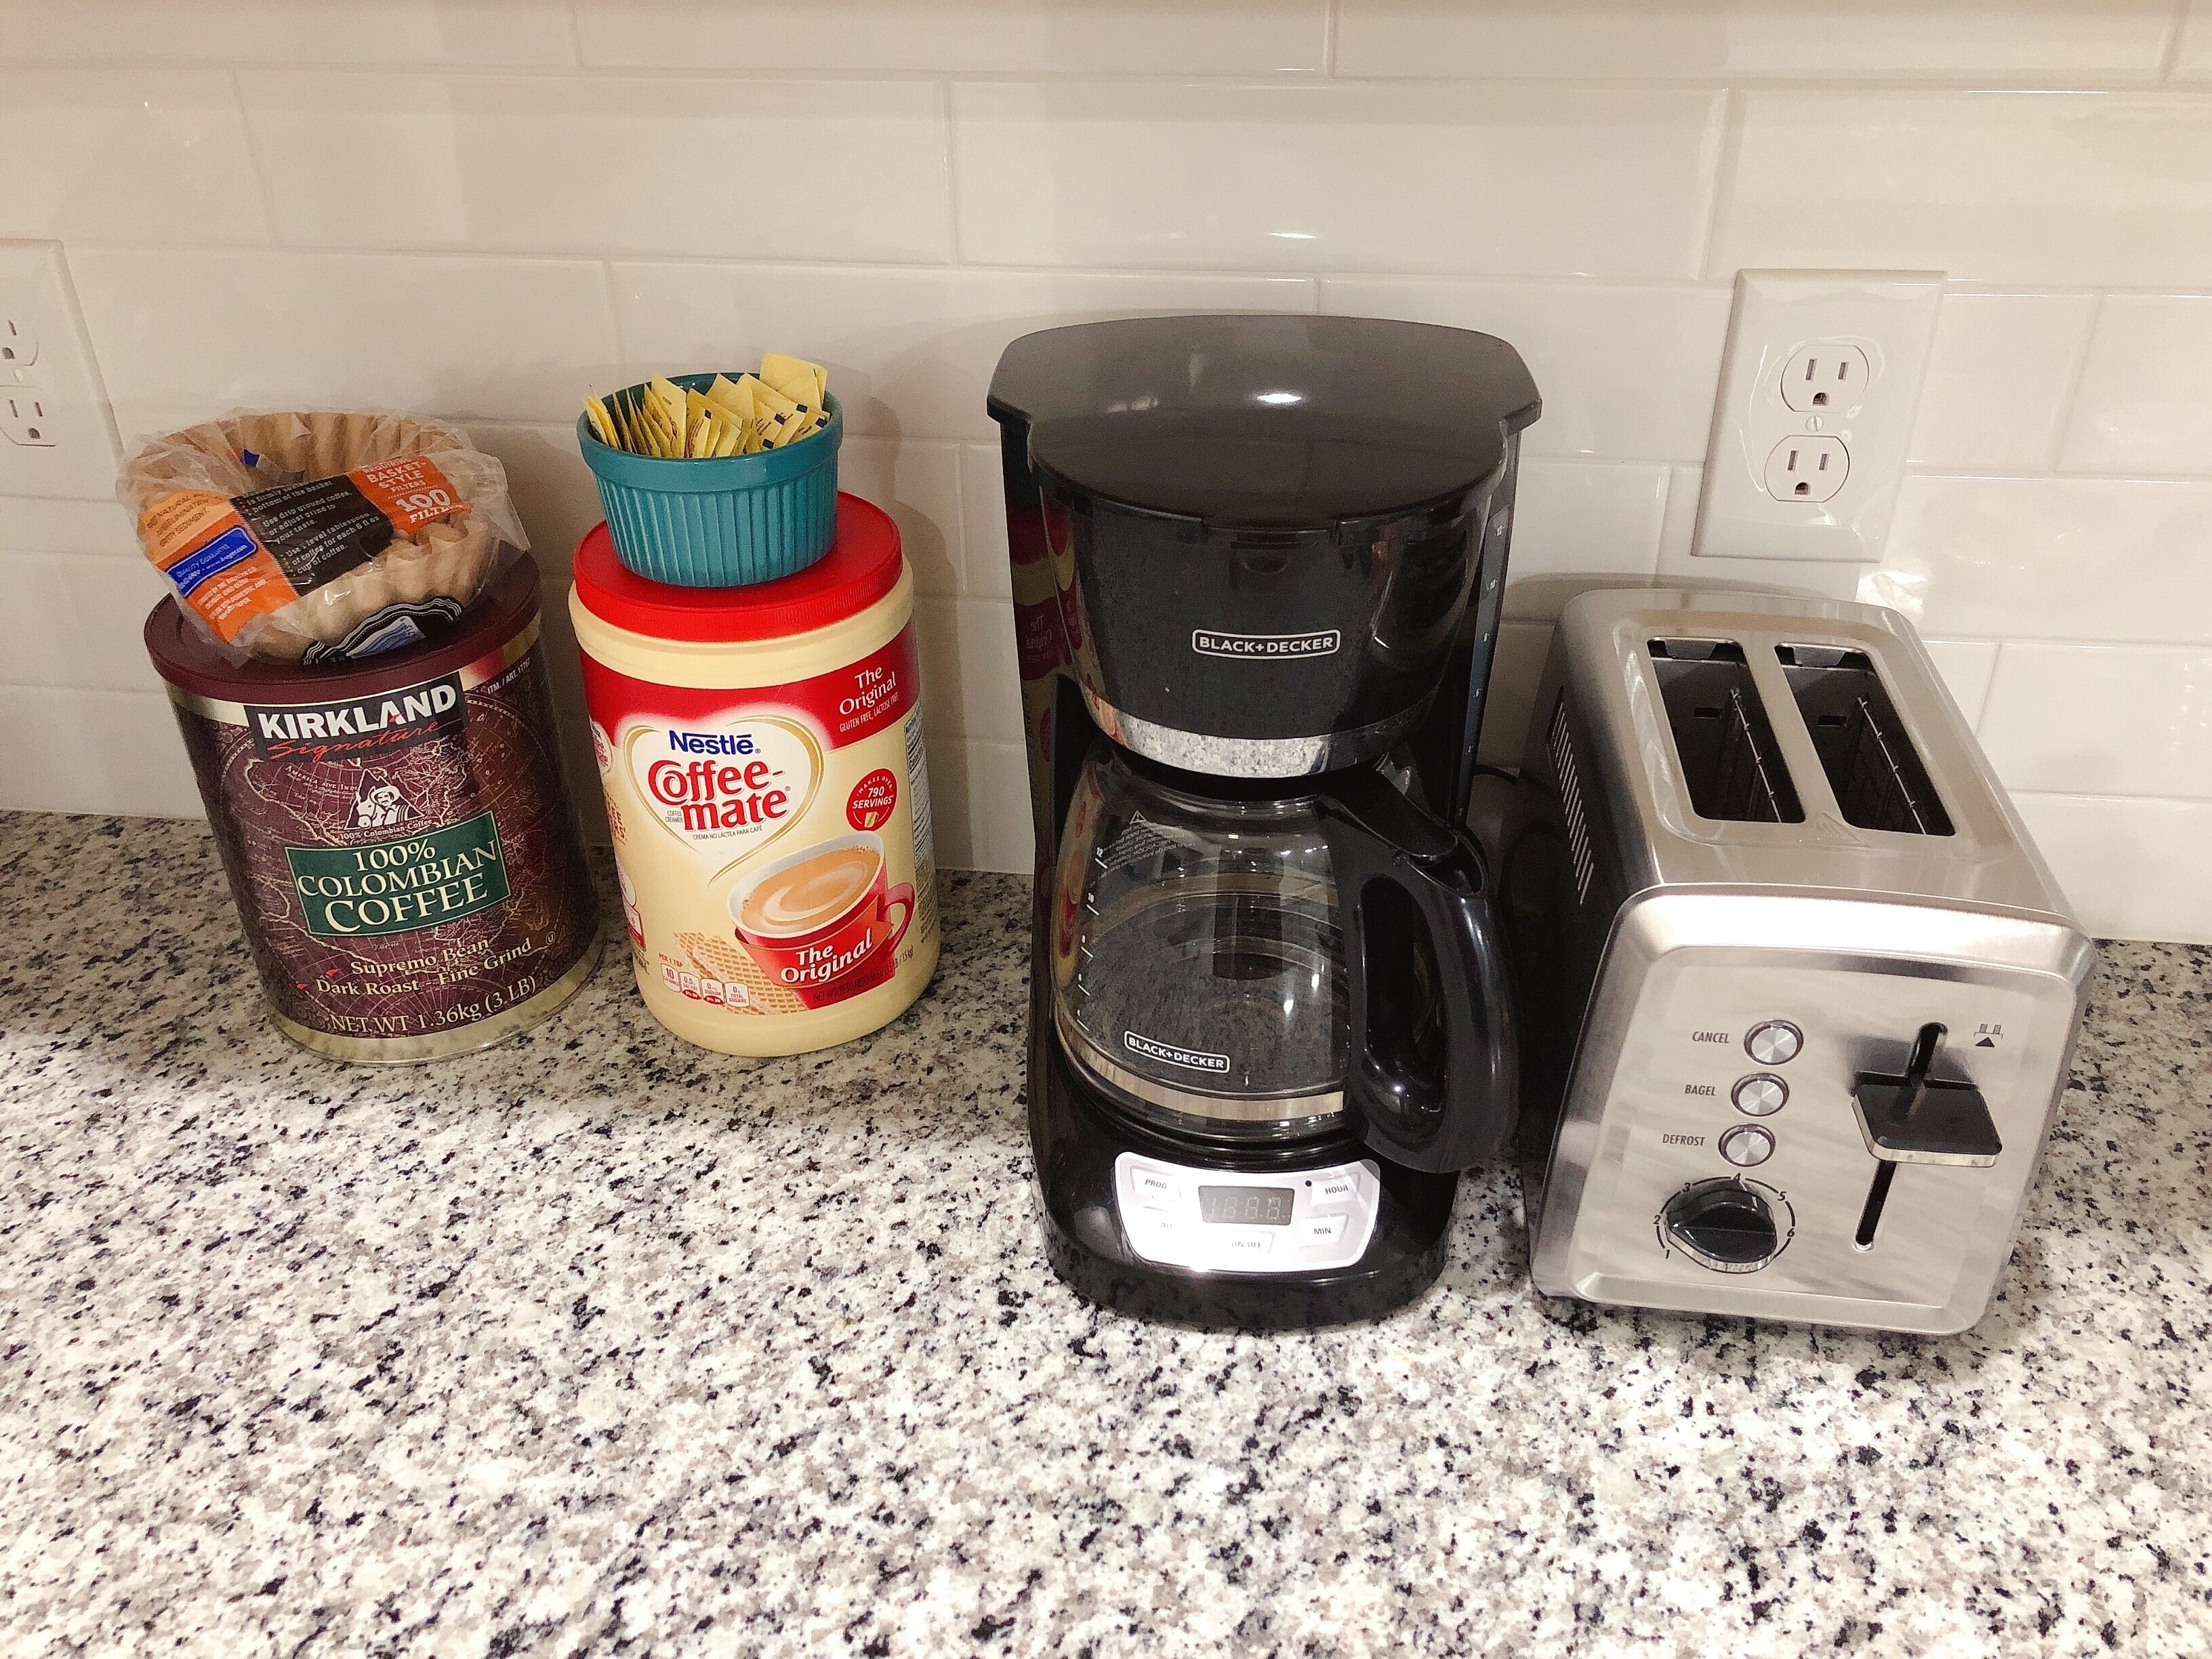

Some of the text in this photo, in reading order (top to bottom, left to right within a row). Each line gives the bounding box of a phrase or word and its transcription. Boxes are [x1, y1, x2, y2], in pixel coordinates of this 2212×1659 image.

[366, 461, 426, 483] BASKET-
[378, 470, 424, 489] STYLE
[390, 480, 426, 493] FILTERS
[251, 497, 283, 514] bottom
[292, 487, 306, 497] the
[396, 489, 451, 512] 100
[262, 514, 279, 528] Use
[279, 508, 297, 522] drip
[297, 497, 326, 513] ground
[268, 529, 278, 537] or
[279, 514, 305, 531] adjust
[304, 506, 327, 518] grind
[274, 520, 318, 546] your taste.
[285, 546, 302, 558] Use
[305, 531, 327, 547] level
[325, 512, 371, 534] tablespoon
[291, 557, 302, 566] of
[324, 539, 336, 551] for
[336, 527, 356, 540] each
[356, 522, 363, 530] 6
[1199, 636, 1333, 653] BLACK+DECKER
[854, 667, 883, 689] The
[839, 671, 896, 715] Original
[257, 684, 457, 739] KIRKLAND
[839, 717, 860, 733] GLUTEN
[266, 718, 462, 764] Signature
[858, 775, 894, 794] MAKES OVER
[867, 785, 885, 798] 790
[680, 790, 787, 831] mate
[340, 819, 432, 840] 100% Colombian Coffee
[736, 828, 750, 836] PARA
[352, 838, 436, 872] 100%
[1096, 846, 1103, 858] 12
[298, 839, 498, 898] COLOMBIAN
[325, 873, 489, 933] COFFEE
[1088, 892, 1094, 903] 10
[350, 937, 491, 978] Supremo Bean
[780, 927, 873, 984] Original
[795, 946, 834, 966] The
[316, 976, 361, 996] Dark
[365, 980, 420, 996] Roast
[437, 965, 478, 987] Fine
[483, 937, 533, 970] Grind
[665, 967, 674, 979] 10
[372, 1015, 409, 1033] WT
[417, 1000, 480, 1030] 1.36kg
[485, 992, 504, 1014] (3
[507, 975, 537, 1002] LB)
[1692, 1031, 1729, 1044] CANCEL
[1128, 1036, 1224, 1069] BLACK+DECKER
[1685, 1084, 1717, 1097] BAGEL
[1662, 1134, 1706, 1147] DEFROST
[1145, 1179, 1167, 1189] PROG
[1733, 1173, 1741, 1181] 4
[1325, 1185, 1349, 1194] HOUR
[1683, 1183, 1691, 1192] 3
[1777, 1191, 1786, 1201] 5
[1653, 1215, 1661, 1225] 2
[1313, 1227, 1331, 1235] MIN
[1787, 1227, 1795, 1237] 6
[1665, 1250, 1671, 1259] 1
